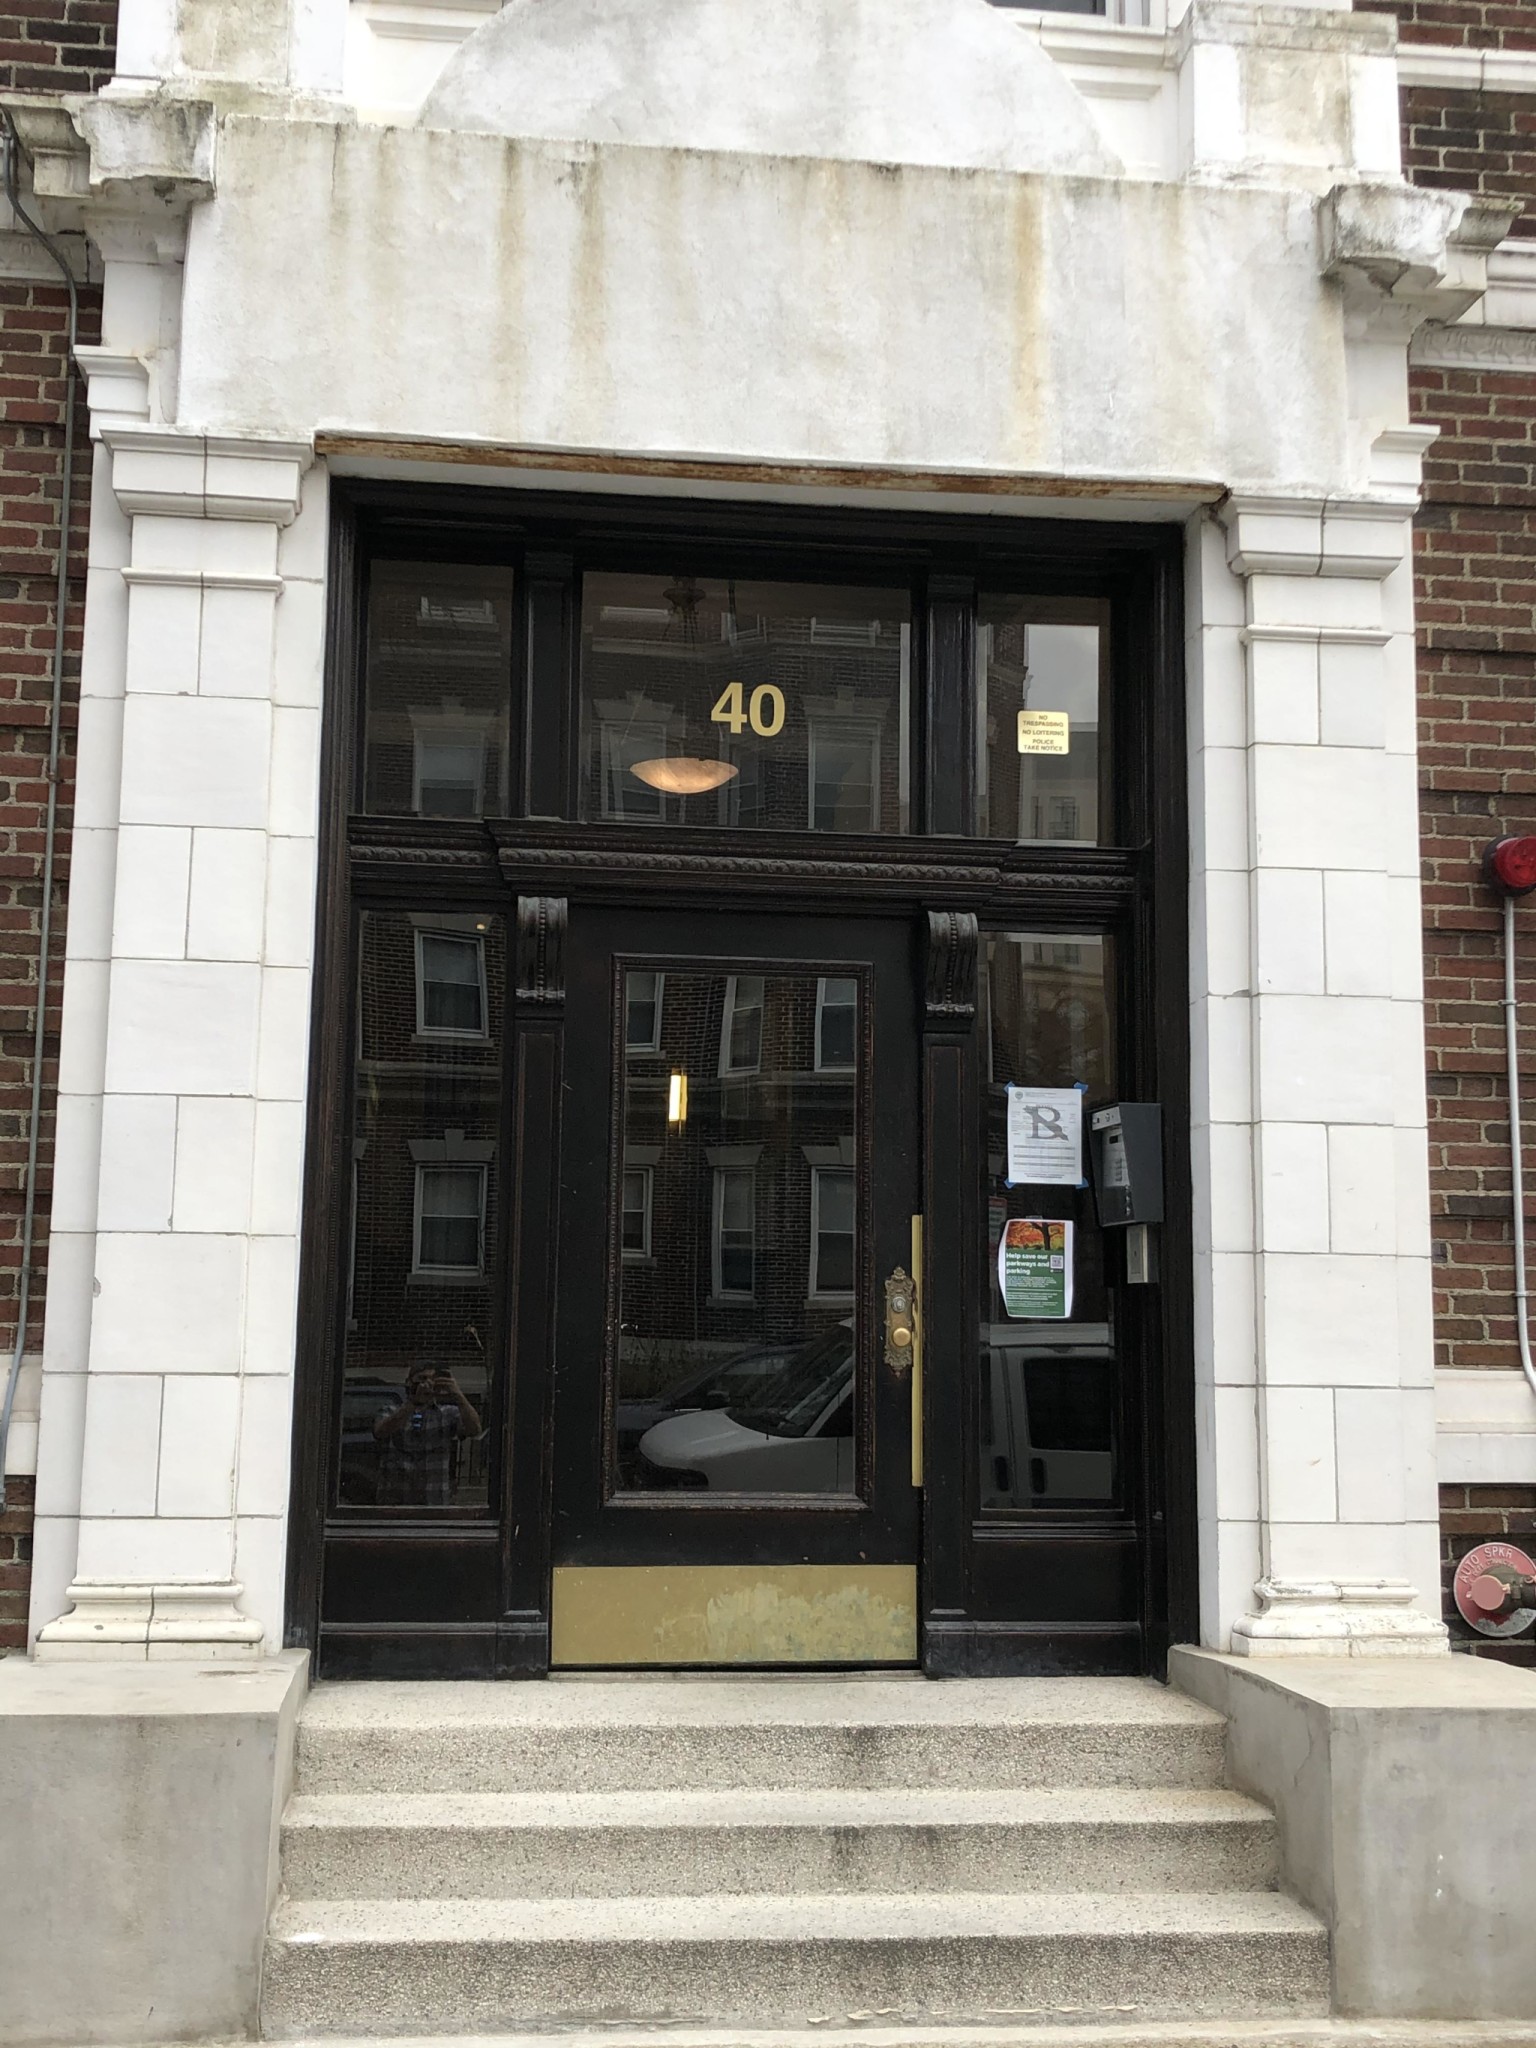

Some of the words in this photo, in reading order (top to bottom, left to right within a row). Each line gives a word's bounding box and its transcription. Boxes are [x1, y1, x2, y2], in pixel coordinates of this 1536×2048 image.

[711, 682, 786, 737] 40
[1006, 1252, 1021, 1260] Help
[1006, 1268, 1031, 1276] parking
[1459, 1554, 1480, 1584] AUTO
[1484, 1546, 1513, 1559] SPKR
